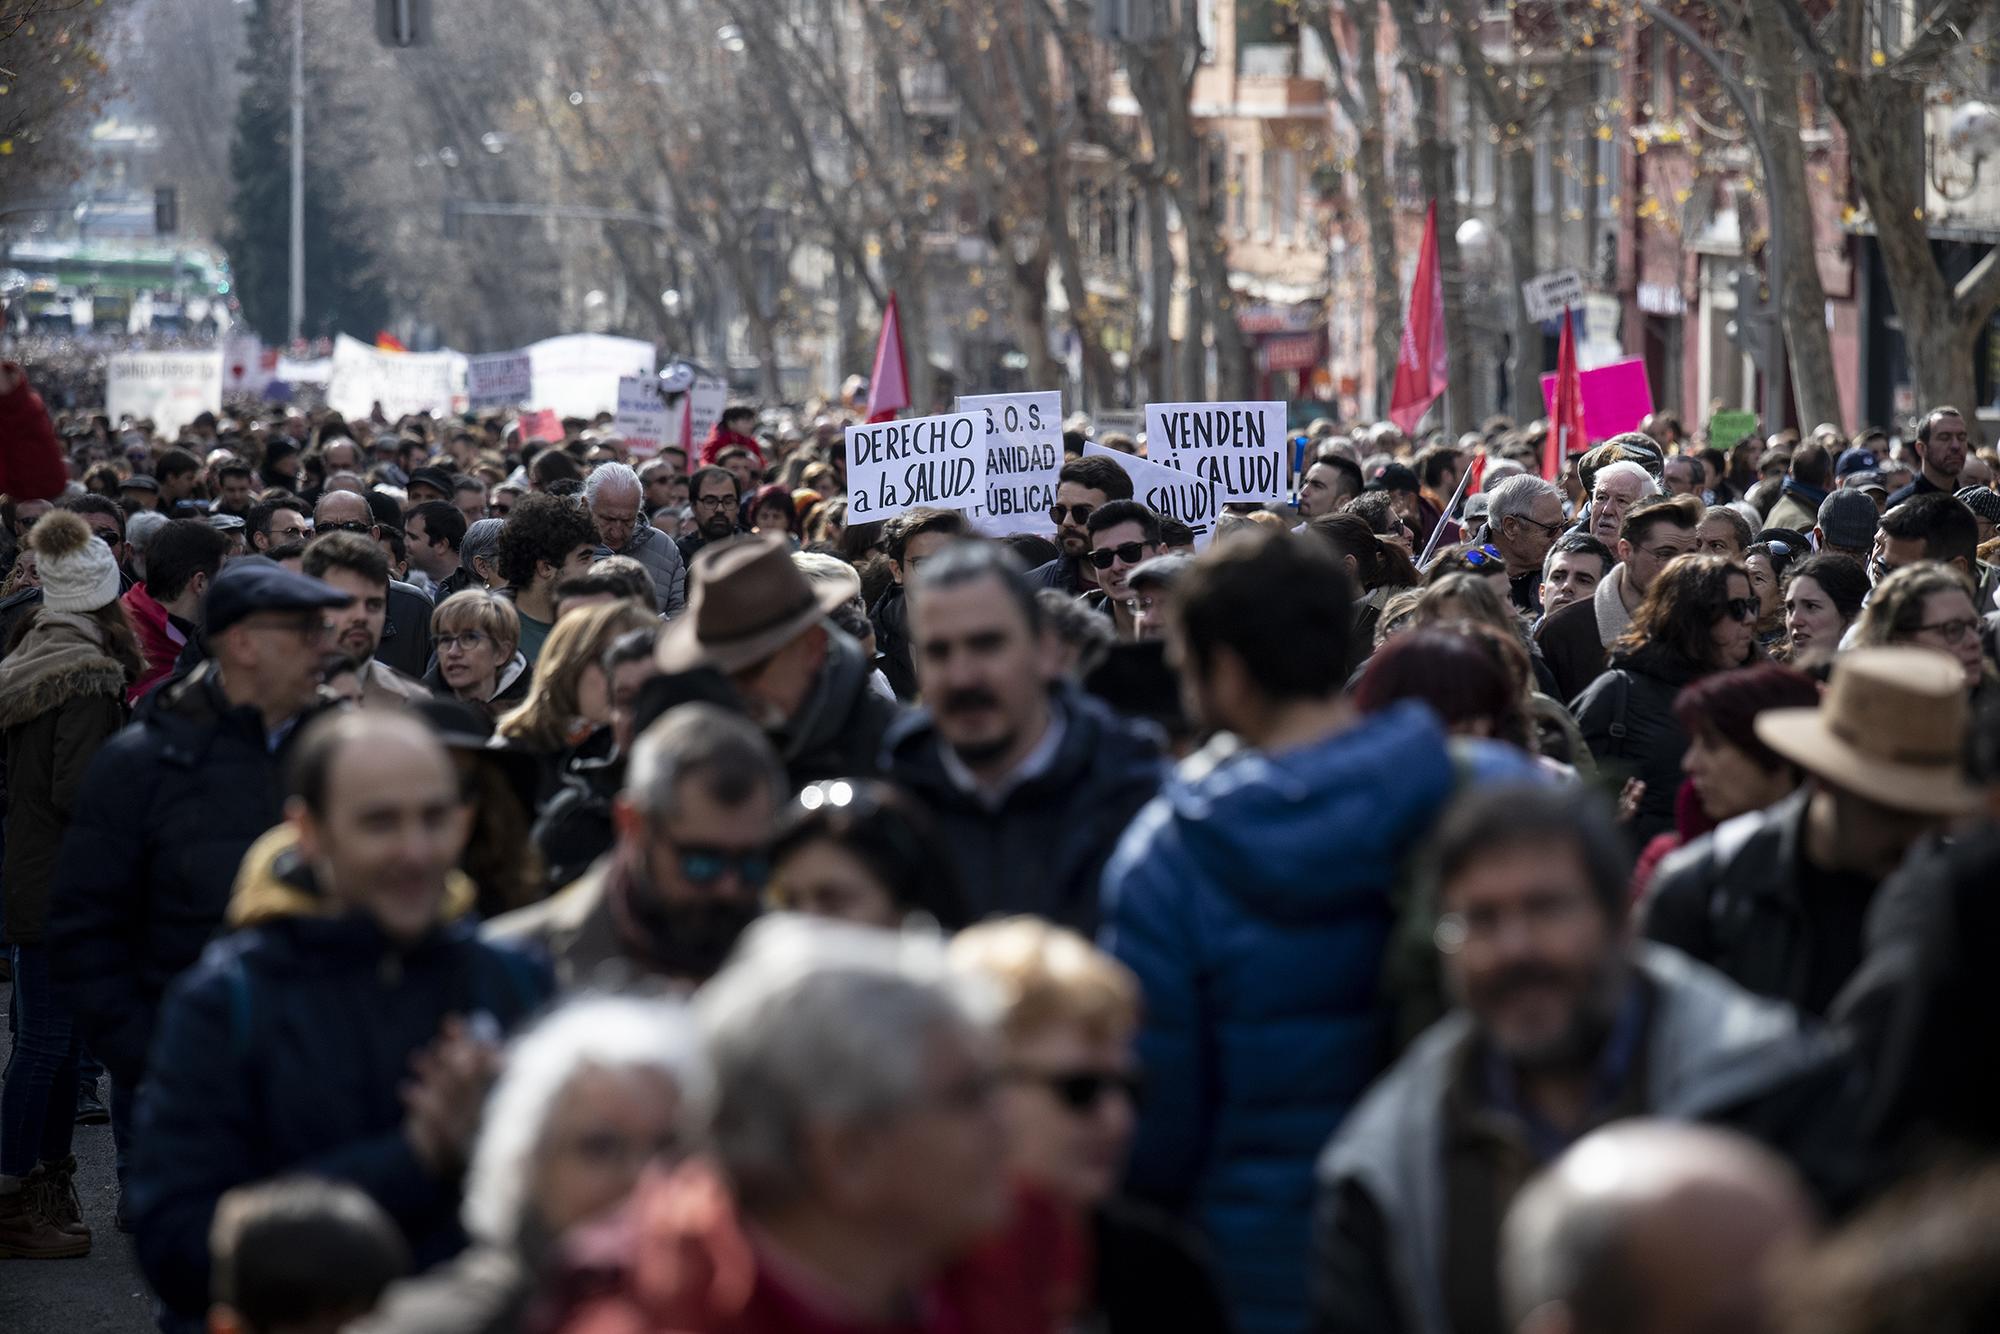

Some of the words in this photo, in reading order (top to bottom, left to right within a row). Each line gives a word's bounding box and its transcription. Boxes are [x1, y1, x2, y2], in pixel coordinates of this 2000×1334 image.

[854, 418, 973, 466] DERECHO
[1161, 410, 1265, 449] VENDEN
[985, 444, 1056, 475] ANIDAD
[854, 490, 872, 512] a
[879, 471, 897, 508] la
[900, 457, 975, 507] SALUD.
